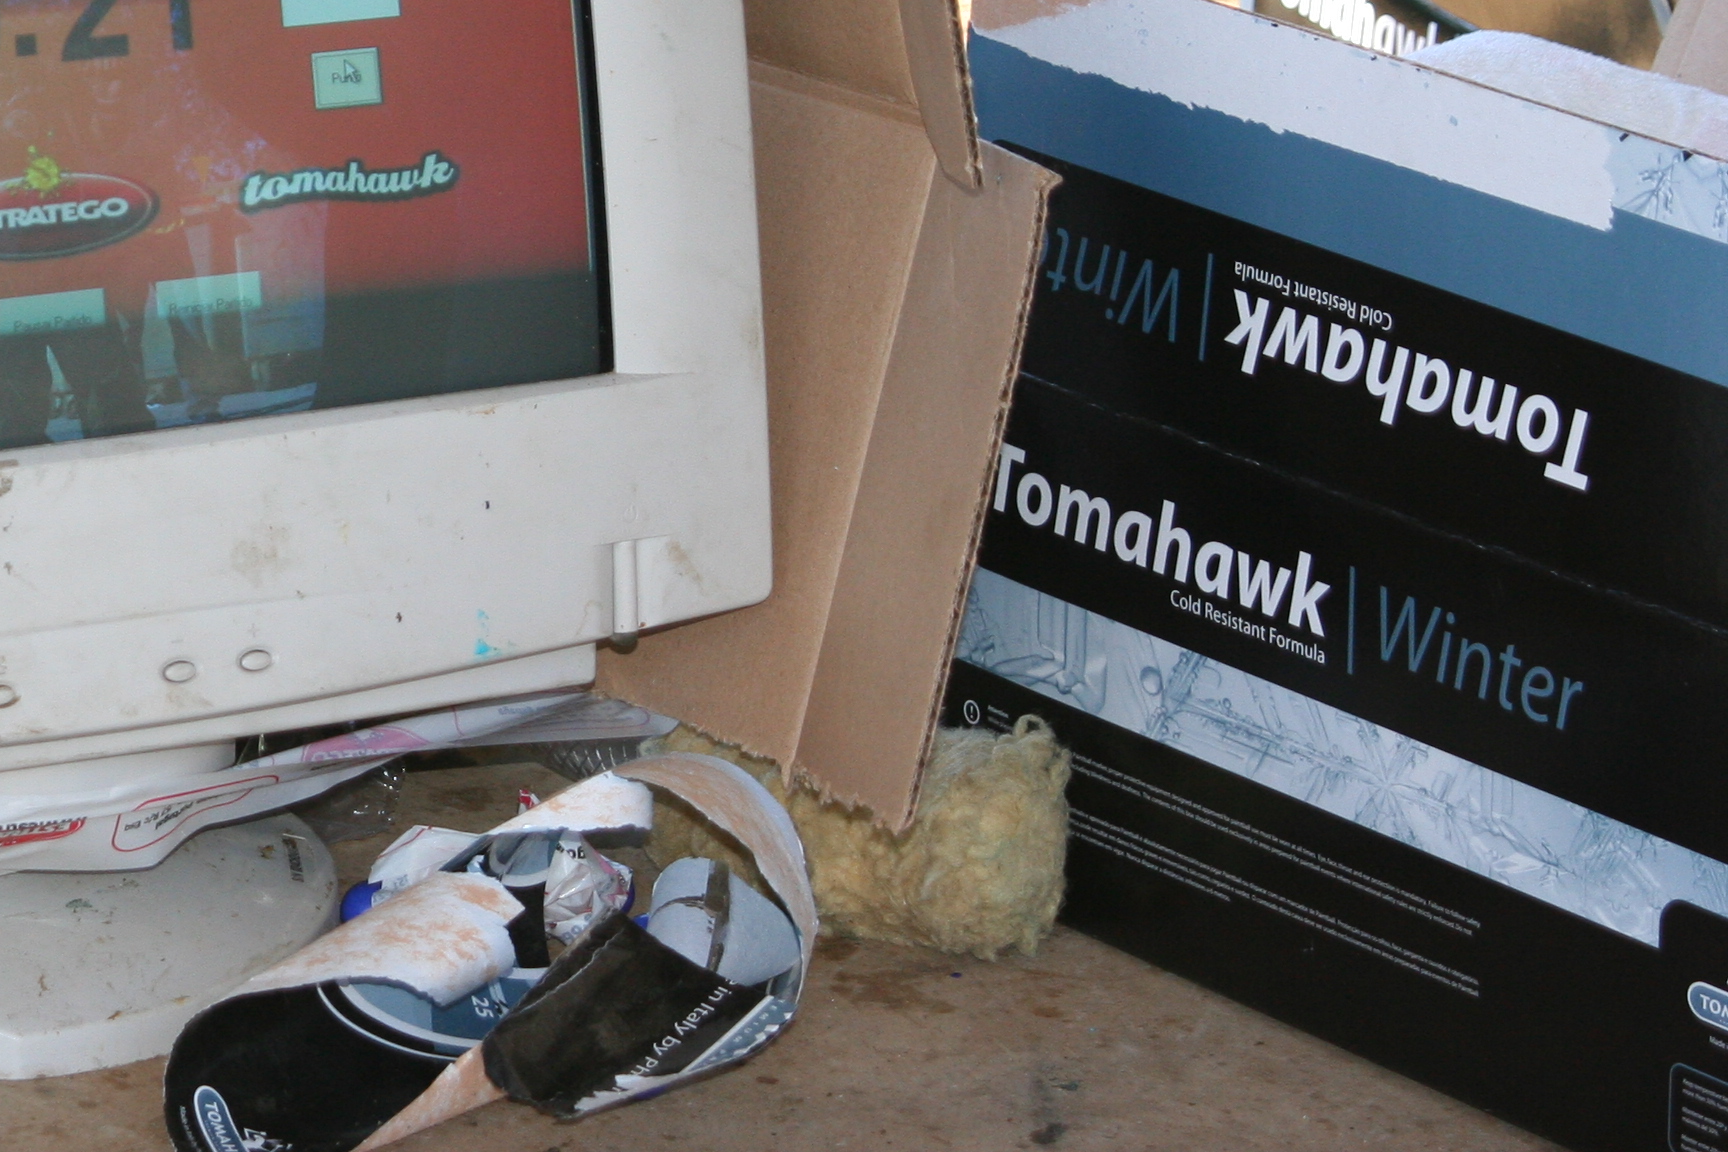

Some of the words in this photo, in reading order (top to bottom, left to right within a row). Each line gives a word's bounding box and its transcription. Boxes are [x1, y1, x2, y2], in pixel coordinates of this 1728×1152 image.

[243, 153, 454, 206] tomahawk
[1234, 261, 1291, 297] Formula
[1294, 280, 1358, 319] Resistant
[1359, 305, 1393, 331] Cold
[1223, 288, 1590, 492] Tomahawk
[993, 442, 1331, 637] Tomahawk
[1379, 585, 1584, 732] Winter
[1169, 589, 1202, 616] Cold
[1204, 597, 1266, 642] Resistant
[1268, 627, 1326, 665] Formula
[708, 985, 734, 1005] in
[674, 1000, 716, 1038] Italy
[652, 1034, 682, 1057] by
